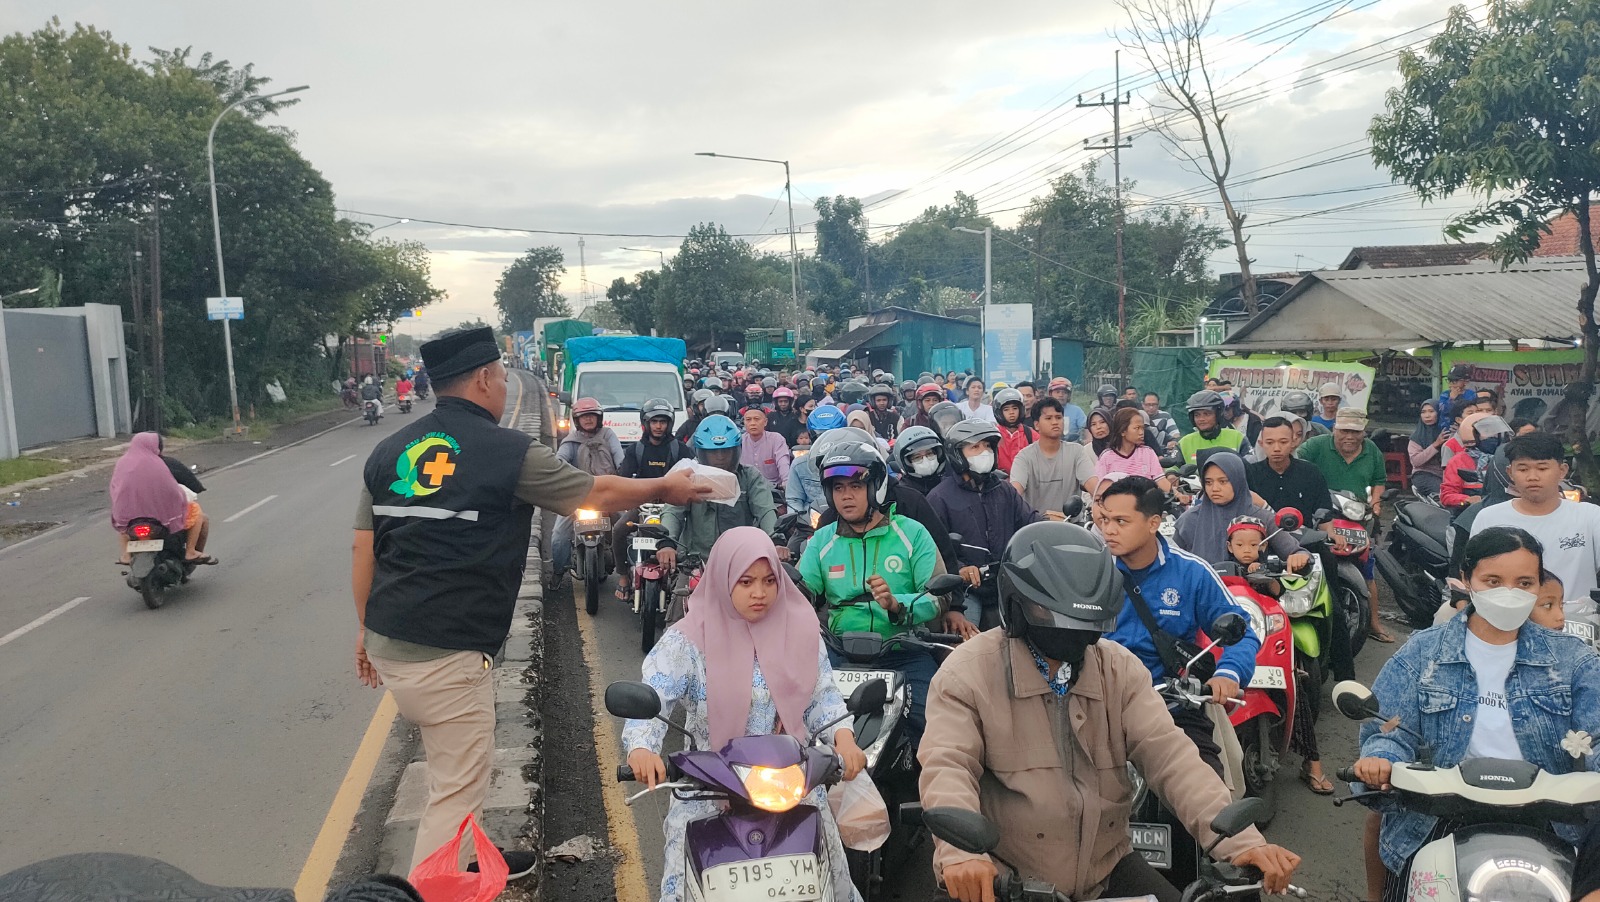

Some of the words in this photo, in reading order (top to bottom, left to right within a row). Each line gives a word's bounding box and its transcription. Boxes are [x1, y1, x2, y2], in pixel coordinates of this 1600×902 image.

[1219, 367, 1284, 389] SUMBER
[1250, 389, 1267, 397] AYAM
[1510, 388, 1533, 396] AYAM
[421, 431, 446, 441] ANWAR
[1072, 602, 1103, 611] HONDA
[1568, 622, 1592, 638] NCN
[839, 672, 869, 683] 2093
[1480, 774, 1515, 783] HONDA
[1132, 830, 1164, 846] NCN
[1496, 859, 1539, 872] SCOOPY
[706, 874, 717, 891] L
[728, 862, 773, 884] 5195
[789, 859, 815, 877] YM
